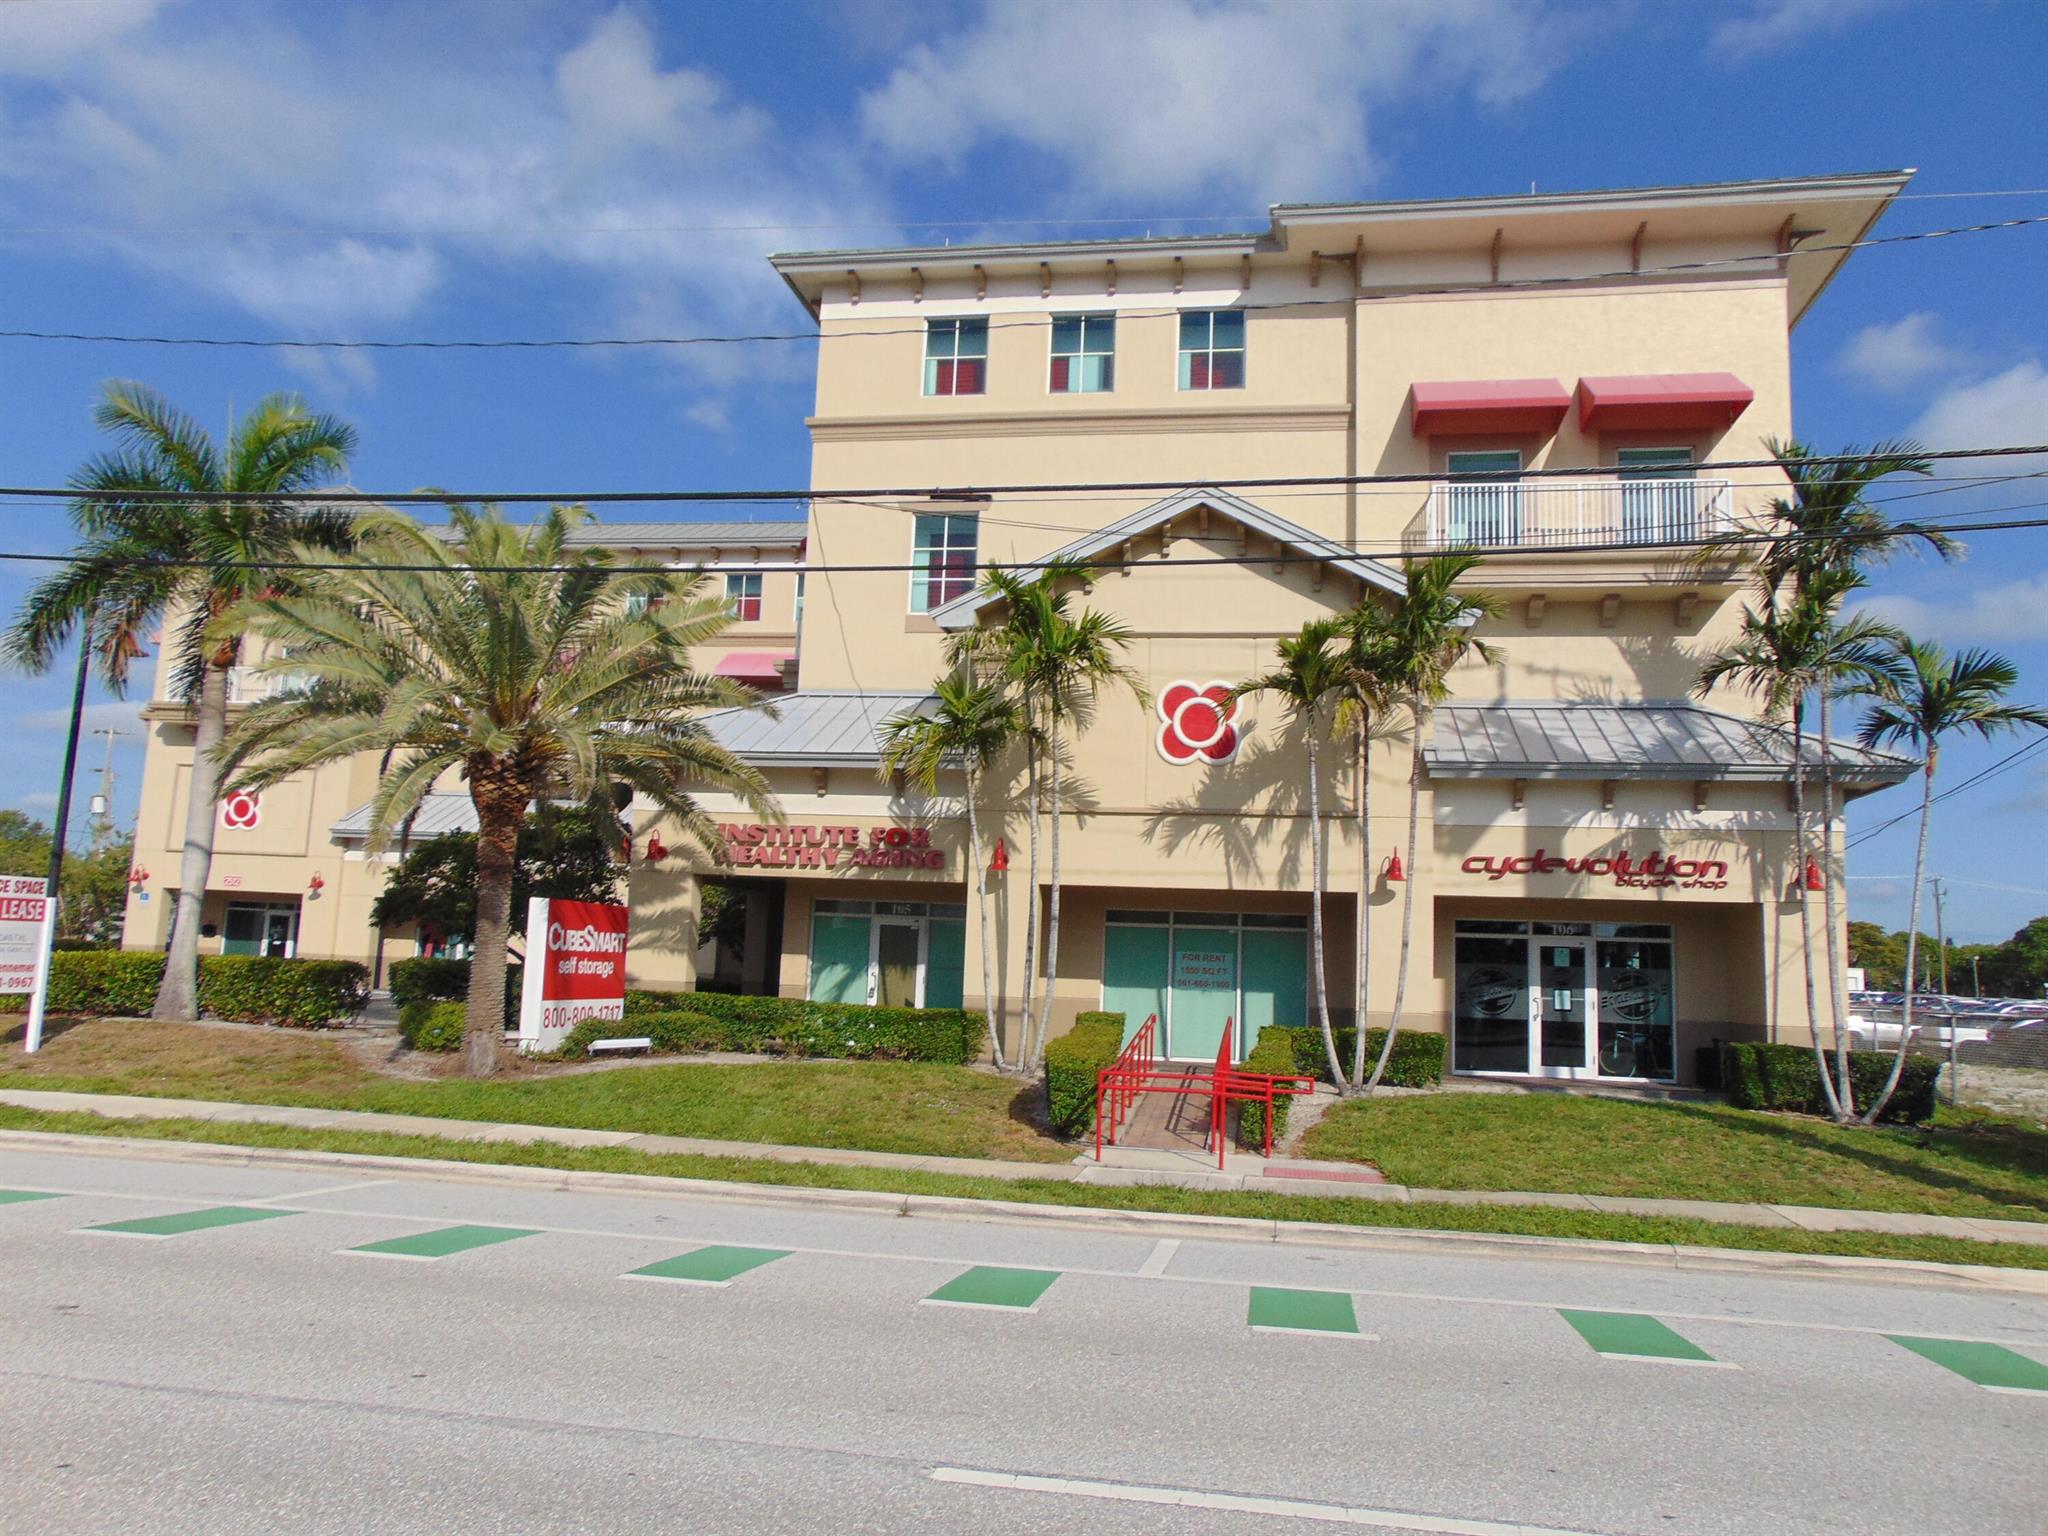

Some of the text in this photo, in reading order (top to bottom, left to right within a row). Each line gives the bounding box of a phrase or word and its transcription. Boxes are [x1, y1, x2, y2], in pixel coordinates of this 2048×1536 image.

[717, 823, 930, 847] INSTITUTE FOR
[718, 844, 945, 870] HEALTHY AGING
[1461, 849, 1728, 881] cyclevolution
[14, 880, 45, 895] SPACE
[1615, 875, 1728, 891] bicycle shop
[2, 900, 43, 920] LEASE
[1551, 924, 1574, 936] 106
[1182, 953, 1226, 962] FOR RENT
[558, 957, 614, 978] self storage
[1202, 967, 1215, 975] SQ
[1217, 967, 1228, 975] FT
